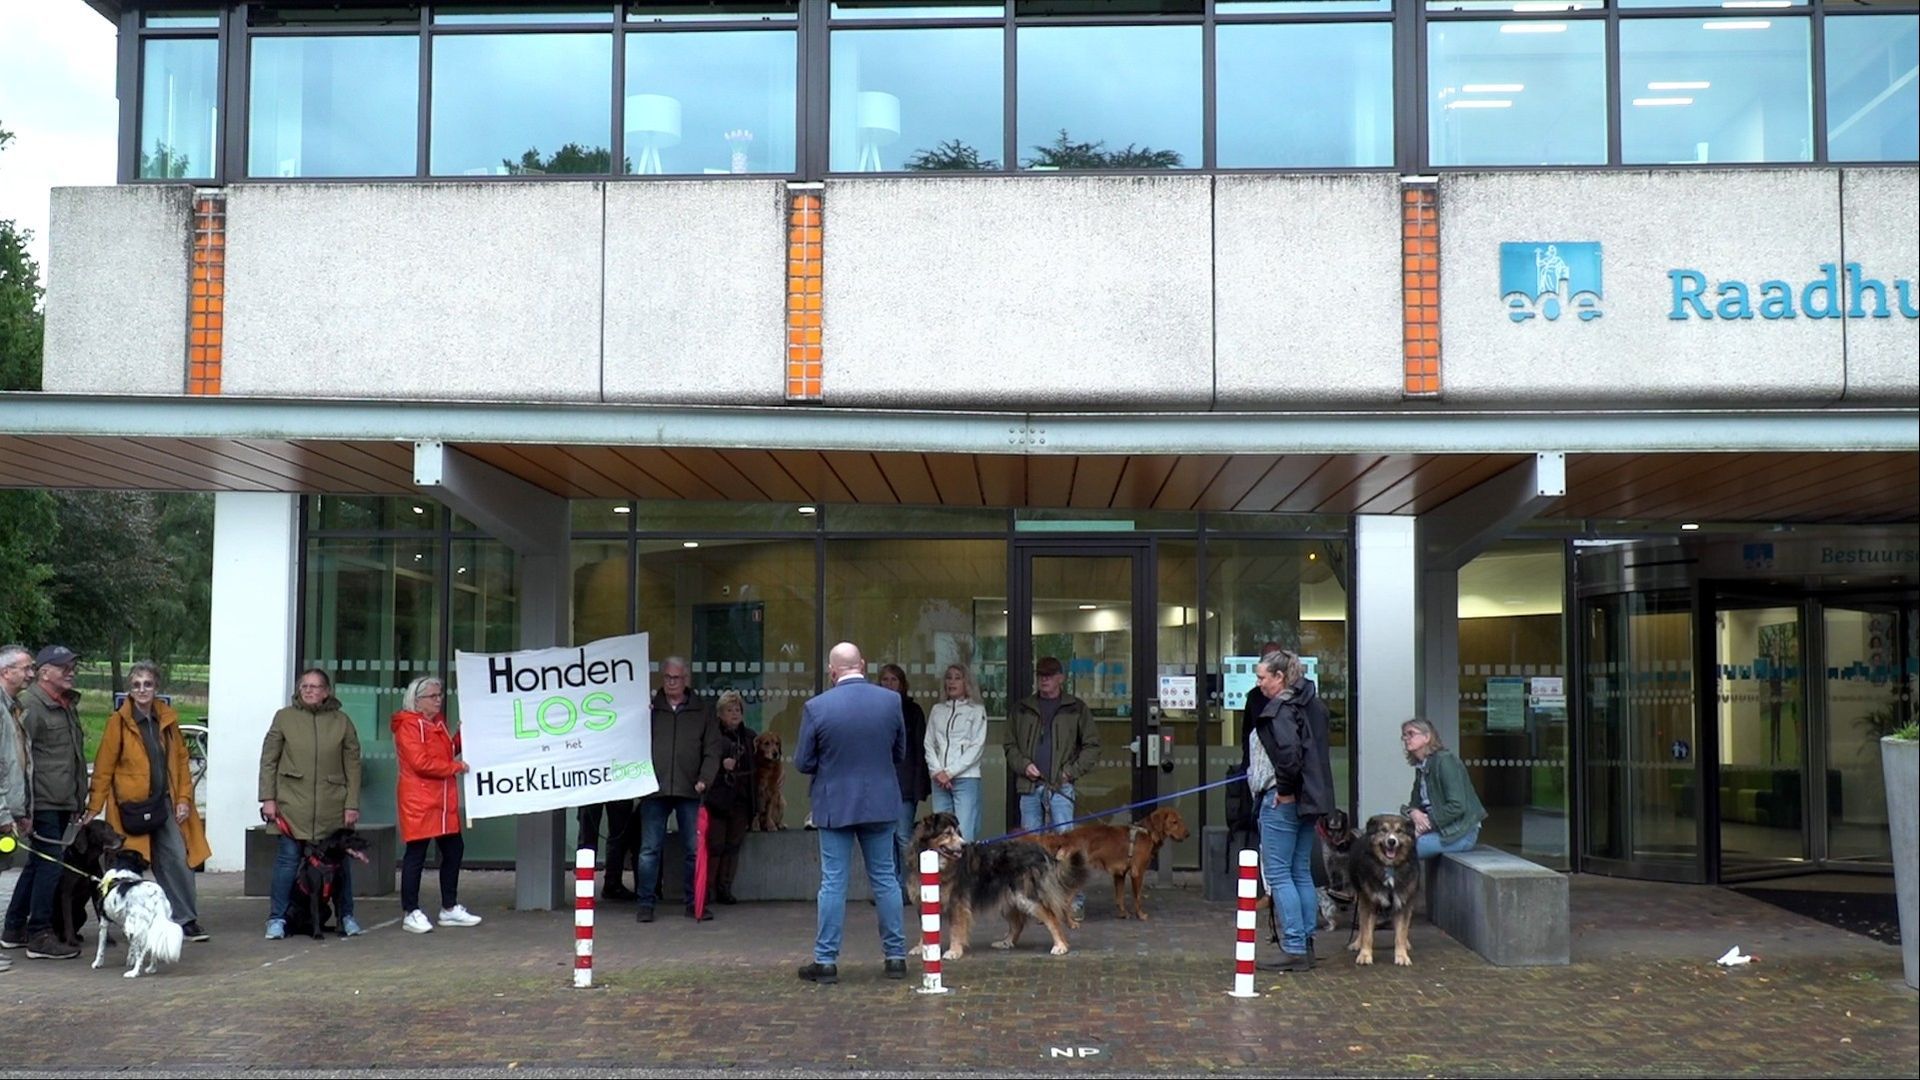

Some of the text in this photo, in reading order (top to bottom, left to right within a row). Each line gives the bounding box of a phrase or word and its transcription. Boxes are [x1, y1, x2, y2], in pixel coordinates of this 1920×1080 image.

[488, 648, 634, 694] Honden
[513, 691, 618, 740] LOS
[541, 738, 583, 752] in het
[1050, 1046, 1100, 1058] NP
